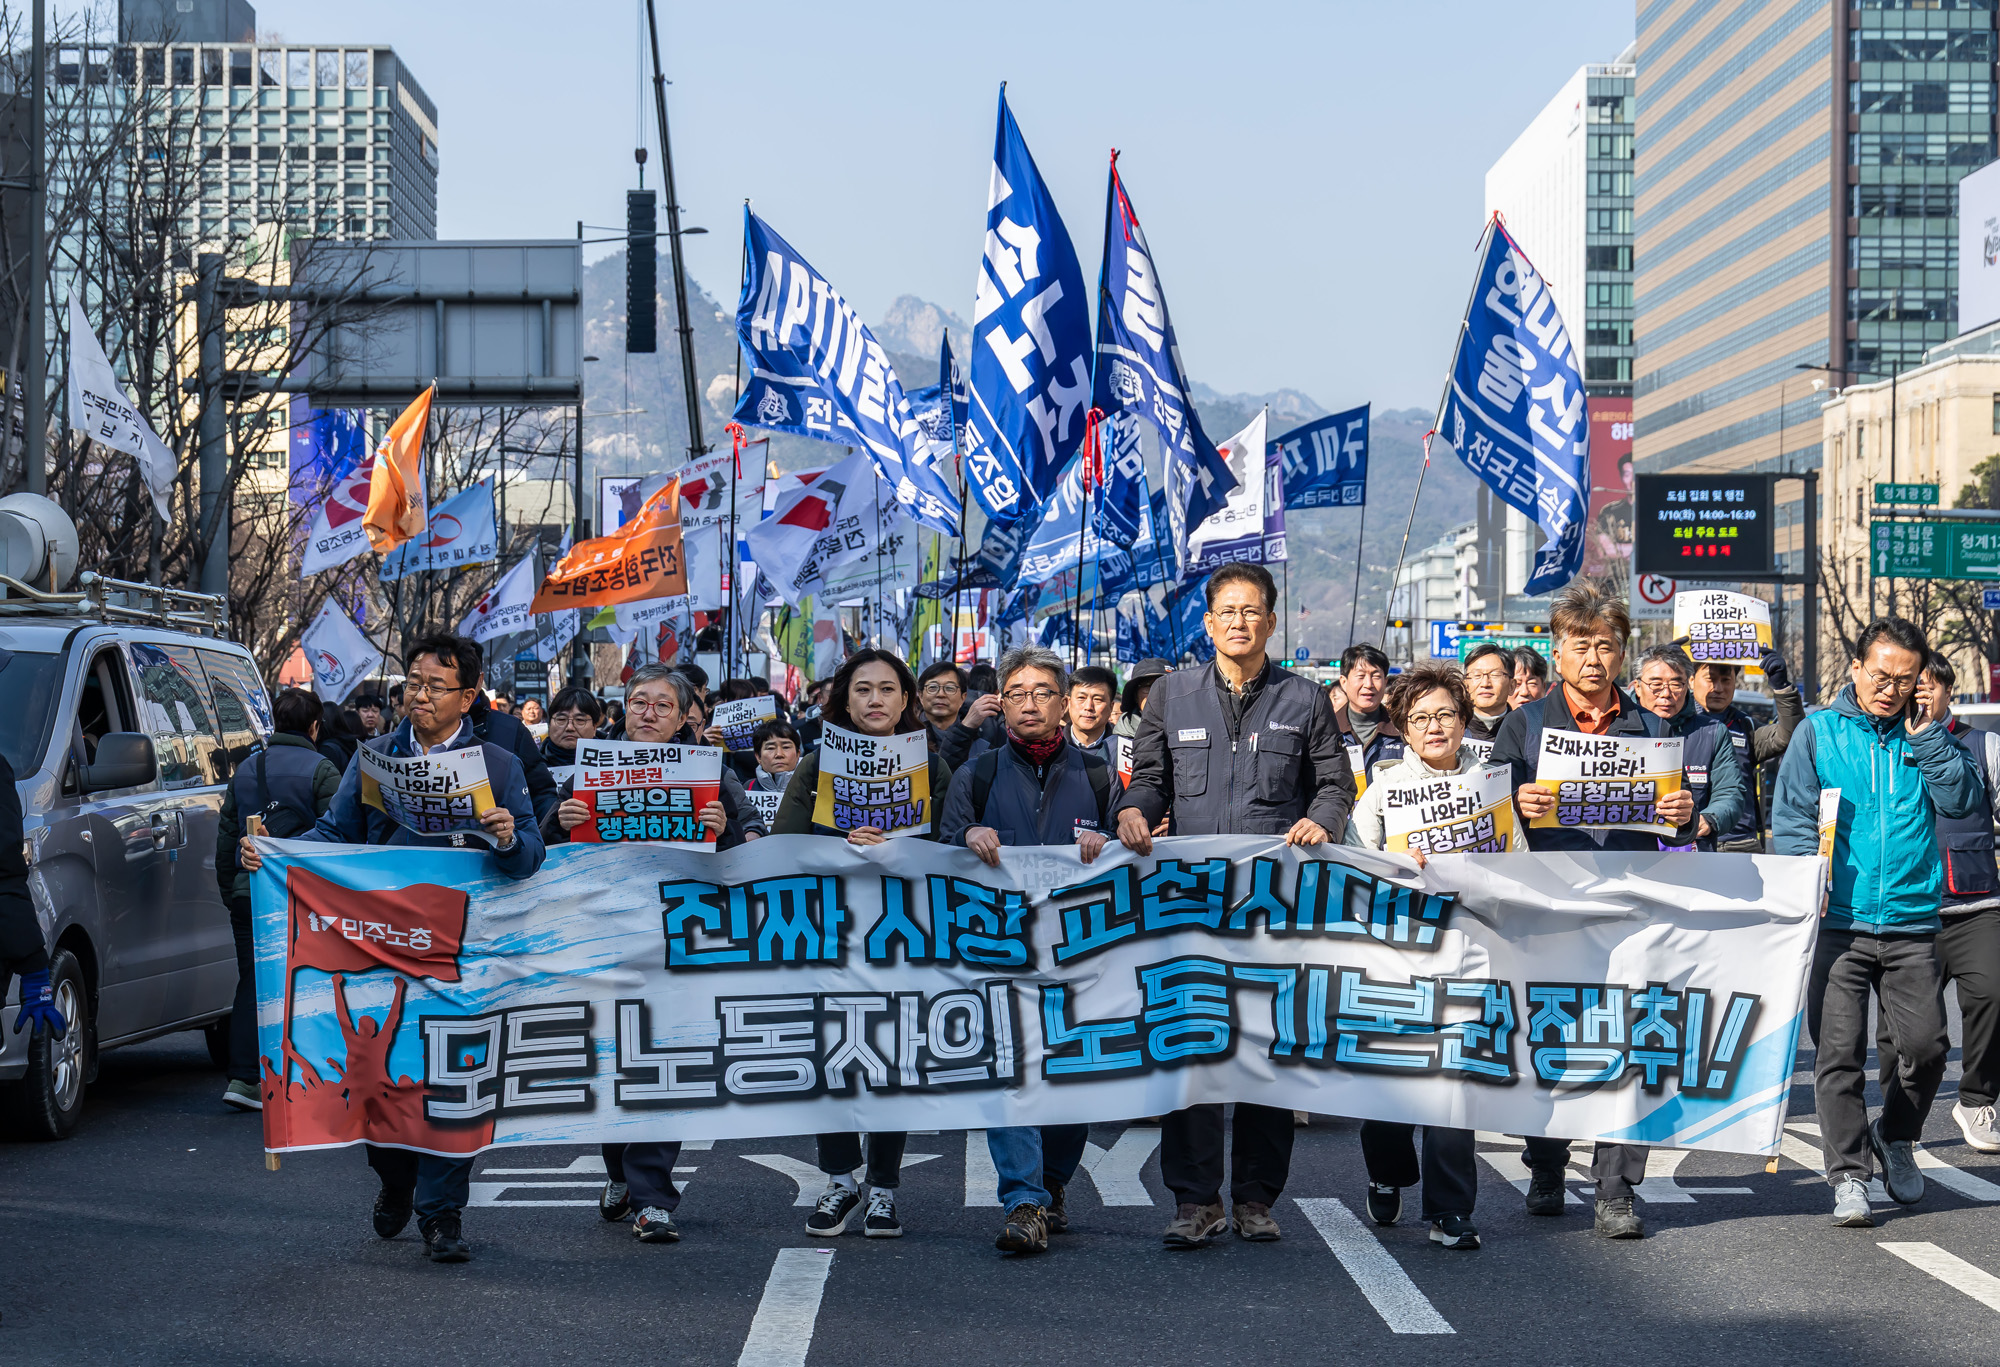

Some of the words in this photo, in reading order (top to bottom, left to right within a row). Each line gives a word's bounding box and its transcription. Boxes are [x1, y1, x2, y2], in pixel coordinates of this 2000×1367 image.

[1485, 247, 1584, 382] 현대
[1667, 490, 1686, 501] 도심
[1690, 490, 1709, 501] 집회
[1712, 490, 1723, 501] 및
[1725, 490, 1745, 501] 행진
[1883, 487, 1933, 500] 청계광장
[1658, 510, 1695, 521] 3/10(화)
[1699, 510, 1756, 520] 14:00~16:30
[1673, 527, 1692, 538] 도심
[1696, 527, 1715, 538] 주요
[1718, 527, 1738, 538] 도로
[1961, 534, 2000, 550] 청계1
[1893, 541, 1934, 556] 광화문
[1703, 607, 1748, 620] 나와라!
[1689, 622, 1757, 640] 원청교섭
[728, 708, 757, 723] 나와라!
[824, 728, 878, 757] 진짜사장
[1545, 734, 1619, 758] 진짜사장
[362, 747, 431, 777] 진짜사장
[581, 748, 614, 767] 모든
[618, 748, 682, 766] 노동자의
[846, 755, 902, 777] 나와라!
[1580, 757, 1646, 778] 나와라!
[394, 771, 460, 794] 나와라!
[584, 767, 663, 787] 노동기본권
[379, 784, 474, 817] 원청교섭
[596, 788, 693, 814] 투쟁으로
[748, 795, 778, 807] 사장
[833, 776, 911, 806] 원청교섭
[1387, 782, 1452, 808] 진짜사장
[1559, 781, 1655, 803] 원청교섭
[834, 800, 924, 831] 쟁취하자!
[1421, 791, 1483, 825] 나와라!
[598, 815, 706, 841] 쟁취하자!
[1407, 813, 1495, 854] 원청교섭
[661, 874, 846, 967] 진짜
[867, 875, 1030, 966] 사장
[1050, 858, 1456, 967] 교섭시대!
[341, 919, 432, 951] 민주노총
[423, 1003, 589, 1121] 모든
[616, 983, 1014, 1101] 노동자의
[1042, 957, 1515, 1078] 노동기본권
[1528, 984, 1756, 1090] 쟁취!
